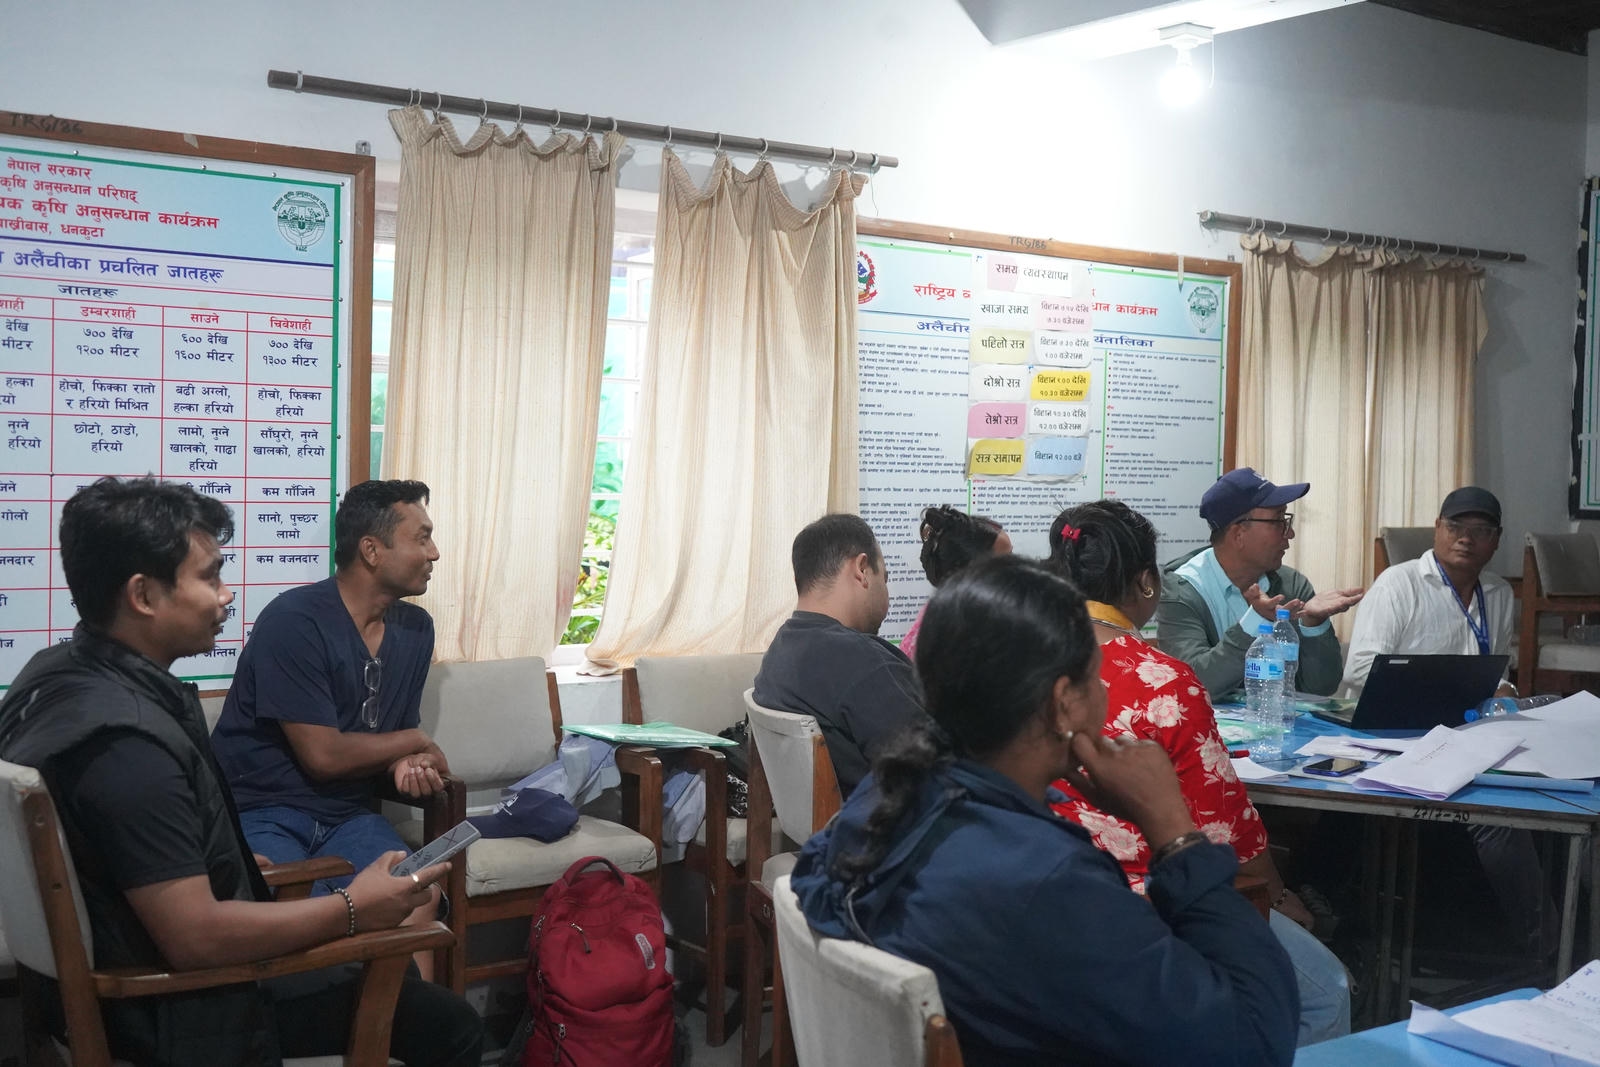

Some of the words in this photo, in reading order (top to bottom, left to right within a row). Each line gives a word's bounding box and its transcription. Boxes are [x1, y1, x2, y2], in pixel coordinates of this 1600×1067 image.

[7, 157, 41, 173] नेपाल
[48, 164, 92, 180] सरकार
[33, 180, 92, 197] अनुसन्धान
[97, 184, 139, 204] परिषद्
[32, 197, 68, 217] कृषि
[75, 203, 151, 222] अनुसन्धान
[158, 211, 220, 229] कार्यक्रम
[61, 223, 105, 240] धनकुटा
[99, 257, 159, 277] प्रचलित
[167, 265, 224, 283] जातहरू
[995, 263, 1018, 275] समय
[58, 284, 118, 299] जातहरू
[980, 303, 1005, 314] खाजा
[1007, 304, 1029, 315] समय
[1116, 303, 1159, 316] कार्यक्रम
[5, 319, 29, 332] देखि
[190, 312, 219, 325] साउने
[83, 327, 106, 338] ७००
[111, 327, 134, 340] देखि
[181, 333, 202, 344] ६००
[207, 332, 229, 345] देखि
[2, 337, 34, 351] मीटर
[268, 339, 289, 350] ७००
[293, 338, 314, 351] देखि
[981, 336, 1007, 349] पहिलो
[1010, 339, 1025, 349] सत्र
[76, 345, 104, 356] १२००
[110, 344, 140, 358] मीटर
[174, 349, 201, 361] १६००
[207, 349, 235, 363] मीटर
[262, 355, 287, 366] १३००
[292, 354, 319, 368] मीटर
[6, 376, 34, 388] हल्का
[92, 378, 127, 393] फिक्का
[133, 382, 156, 394] रातो
[1007, 379, 1021, 388] सत्र
[176, 383, 196, 396] बढी
[289, 388, 322, 402] फिक्का
[65, 398, 74, 409] र
[79, 397, 110, 411] हरियो
[115, 397, 149, 411] मिश्रित
[173, 402, 199, 413] हल्का
[204, 401, 234, 415] हरियो
[275, 404, 304, 418] हरियो
[1004, 415, 1019, 425] सत्र
[74, 422, 104, 436] छोटो,
[111, 423, 139, 437] ठाडो,
[178, 424, 205, 438] लामो,
[8, 436, 42, 449] हरियो
[91, 439, 123, 453] हरियो
[170, 441, 208, 456] खालको,
[214, 444, 237, 455] गाढा
[253, 444, 291, 458] खालको,
[297, 445, 326, 458] हरियो
[975, 453, 991, 463] सत्र
[189, 458, 218, 472] हरियो
[199, 481, 232, 494] गाँजिने
[262, 486, 280, 497] कम
[285, 483, 316, 497] गाँजिने
[1, 508, 29, 521] गोलो
[258, 511, 283, 525] सानो,
[290, 513, 319, 526] पुच्छर
[276, 528, 300, 539] लामो
[256, 554, 274, 564] कम
[279, 554, 320, 564] वजनदार
